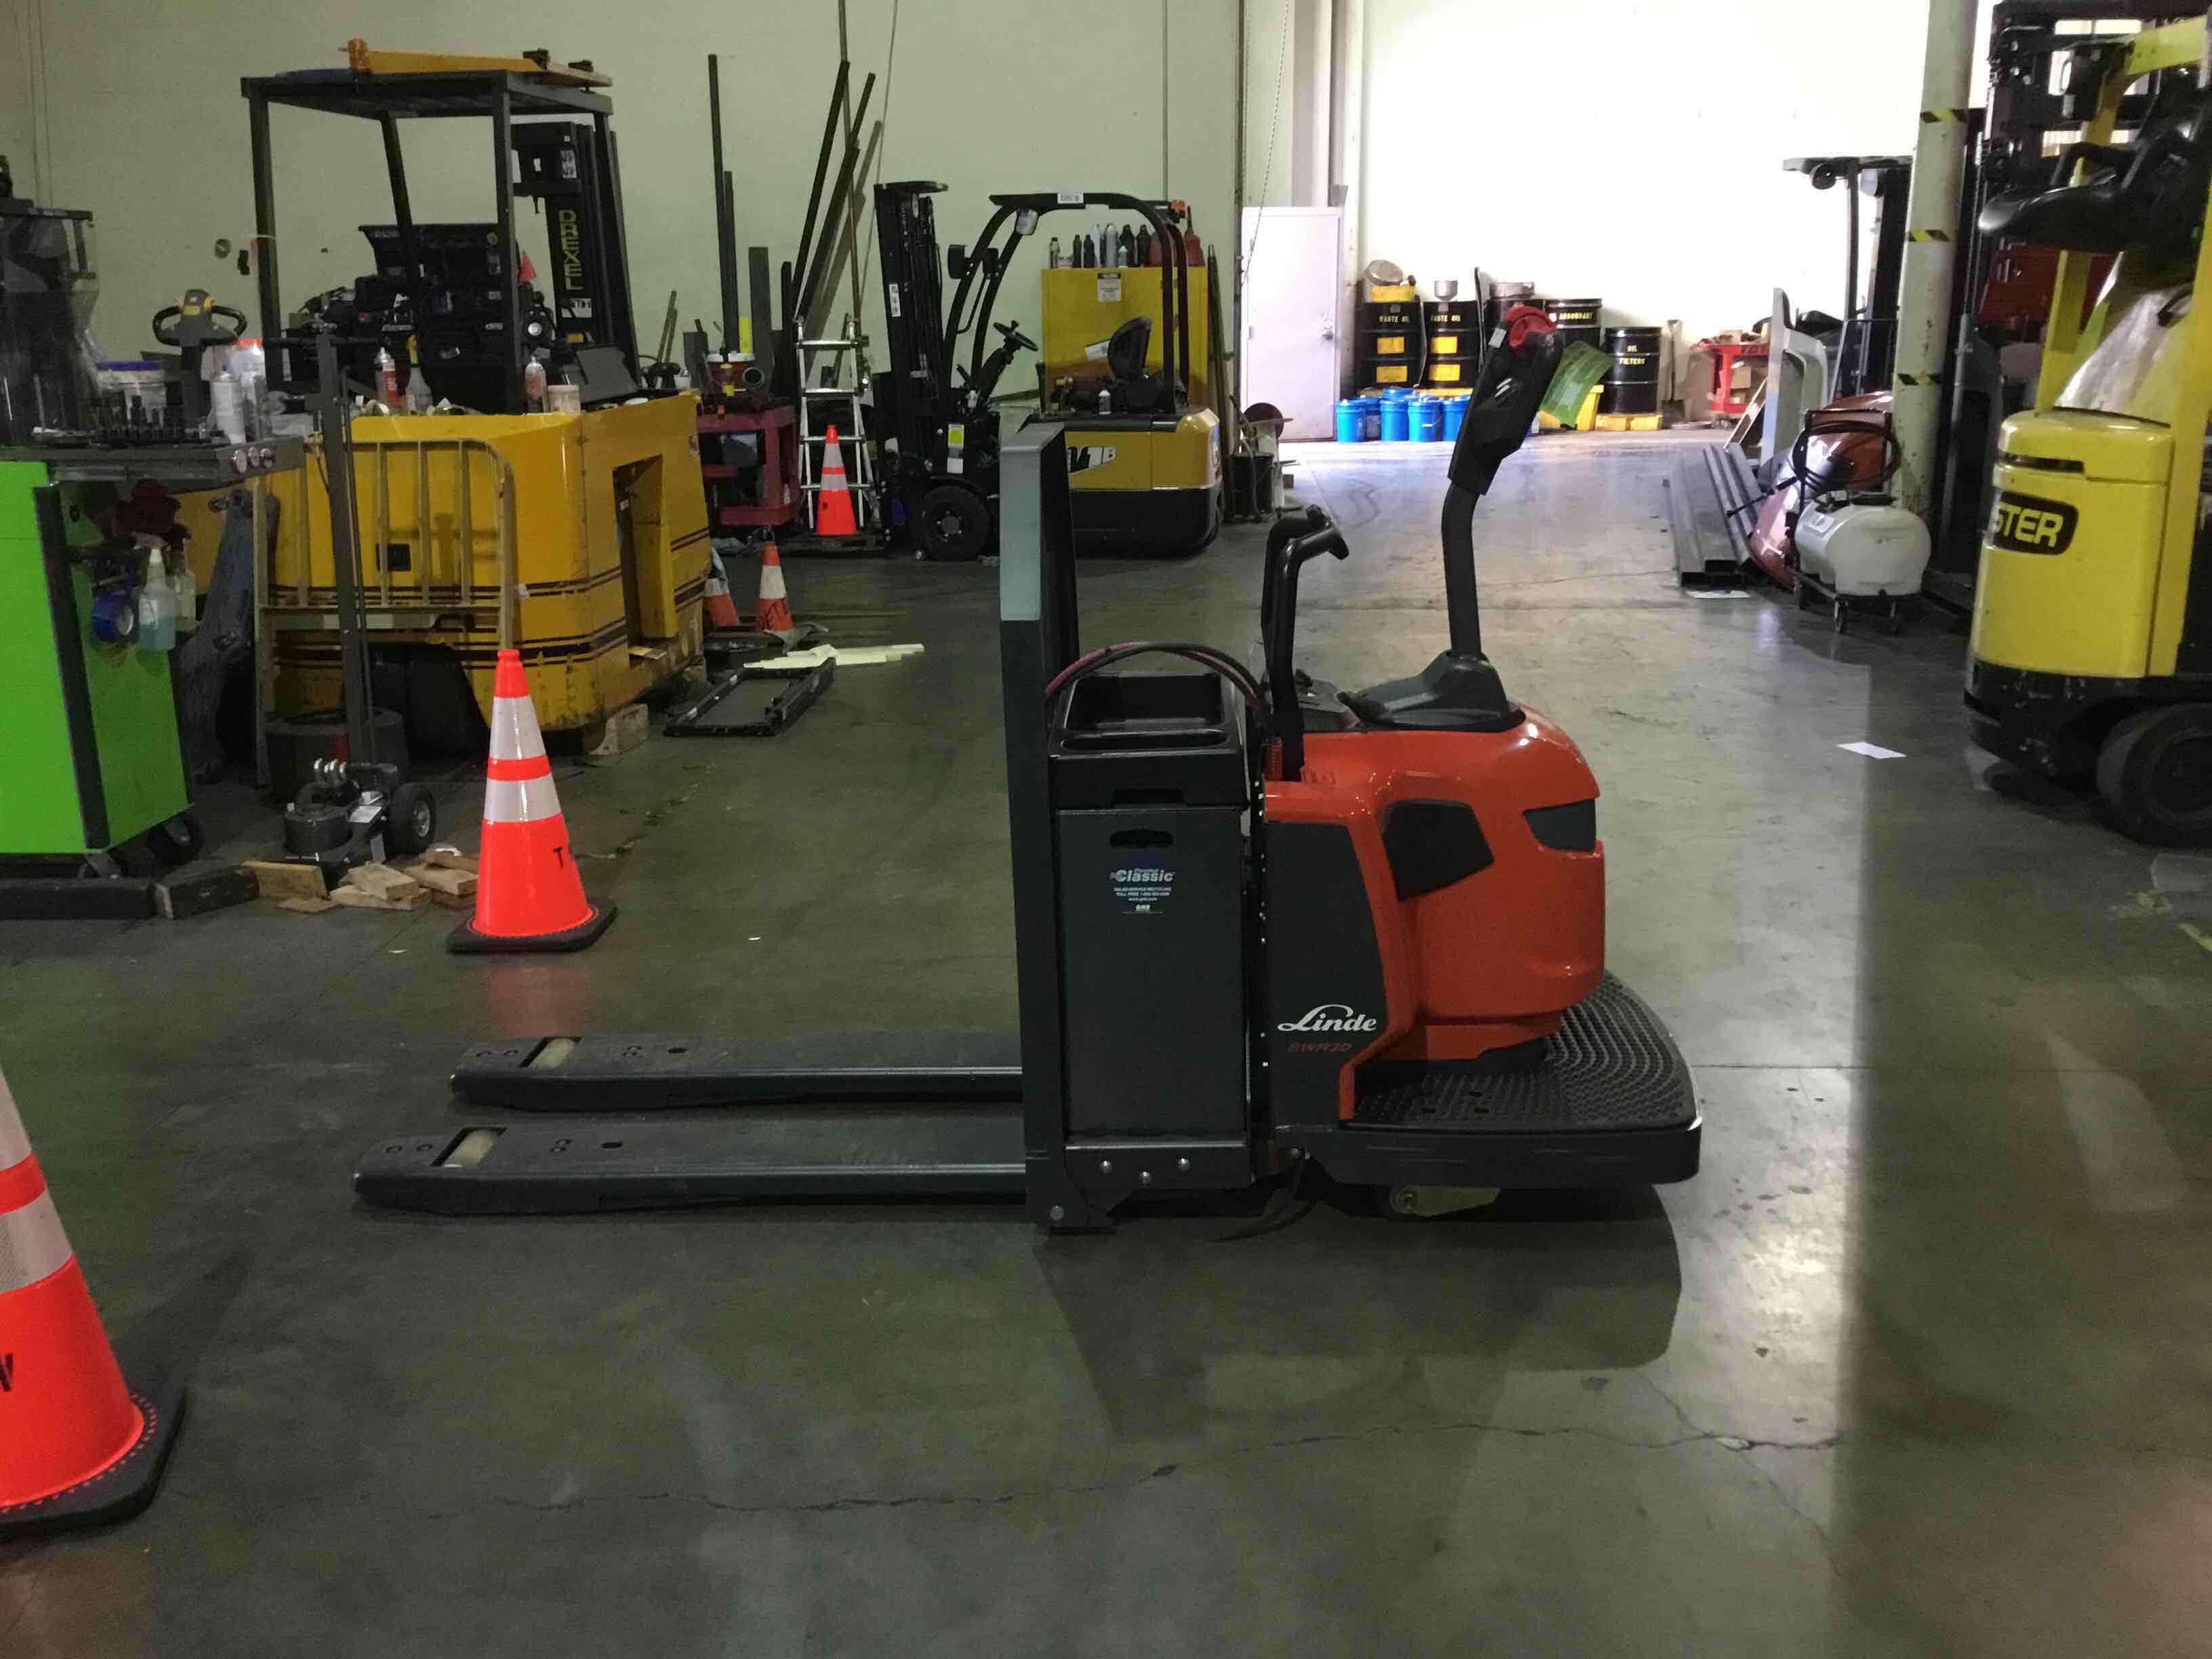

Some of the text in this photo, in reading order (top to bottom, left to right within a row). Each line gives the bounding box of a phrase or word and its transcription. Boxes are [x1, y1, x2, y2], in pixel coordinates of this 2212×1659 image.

[559, 209, 583, 290] DREXEL
[1115, 869, 1174, 882] Classic
[1277, 1004, 1377, 1031] Linde
